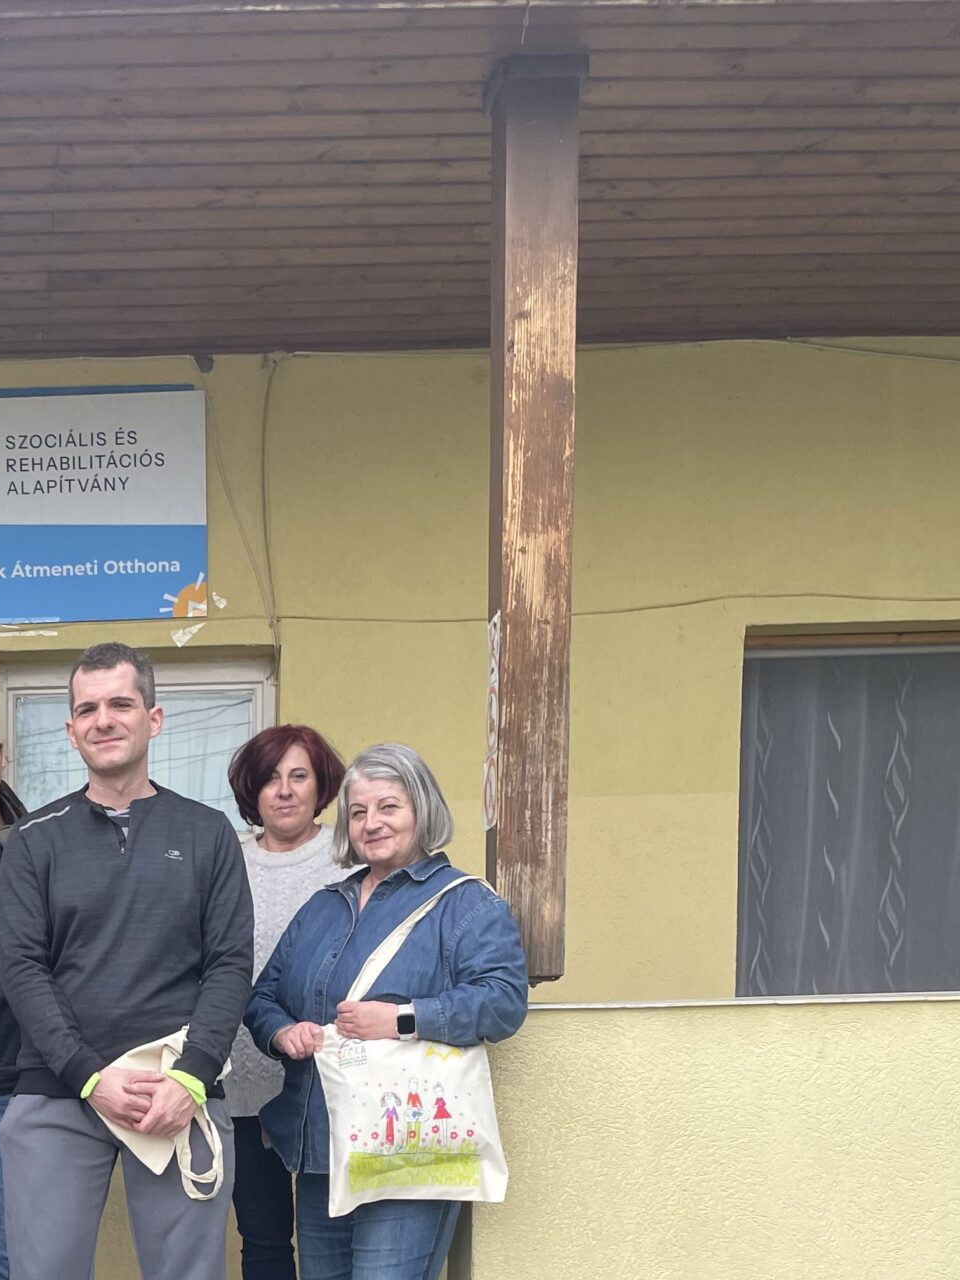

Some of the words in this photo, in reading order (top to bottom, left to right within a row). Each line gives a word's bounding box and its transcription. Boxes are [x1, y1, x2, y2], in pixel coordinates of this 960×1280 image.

[5, 428, 107, 450] SZOCIÁLIS
[115, 427, 138, 446] ÉS
[6, 448, 166, 473] REHABILITÁCIÓS
[7, 473, 130, 496] ALAPÍTVÁNY
[11, 560, 99, 579] Átmeneti
[103, 558, 181, 576] Otthona
